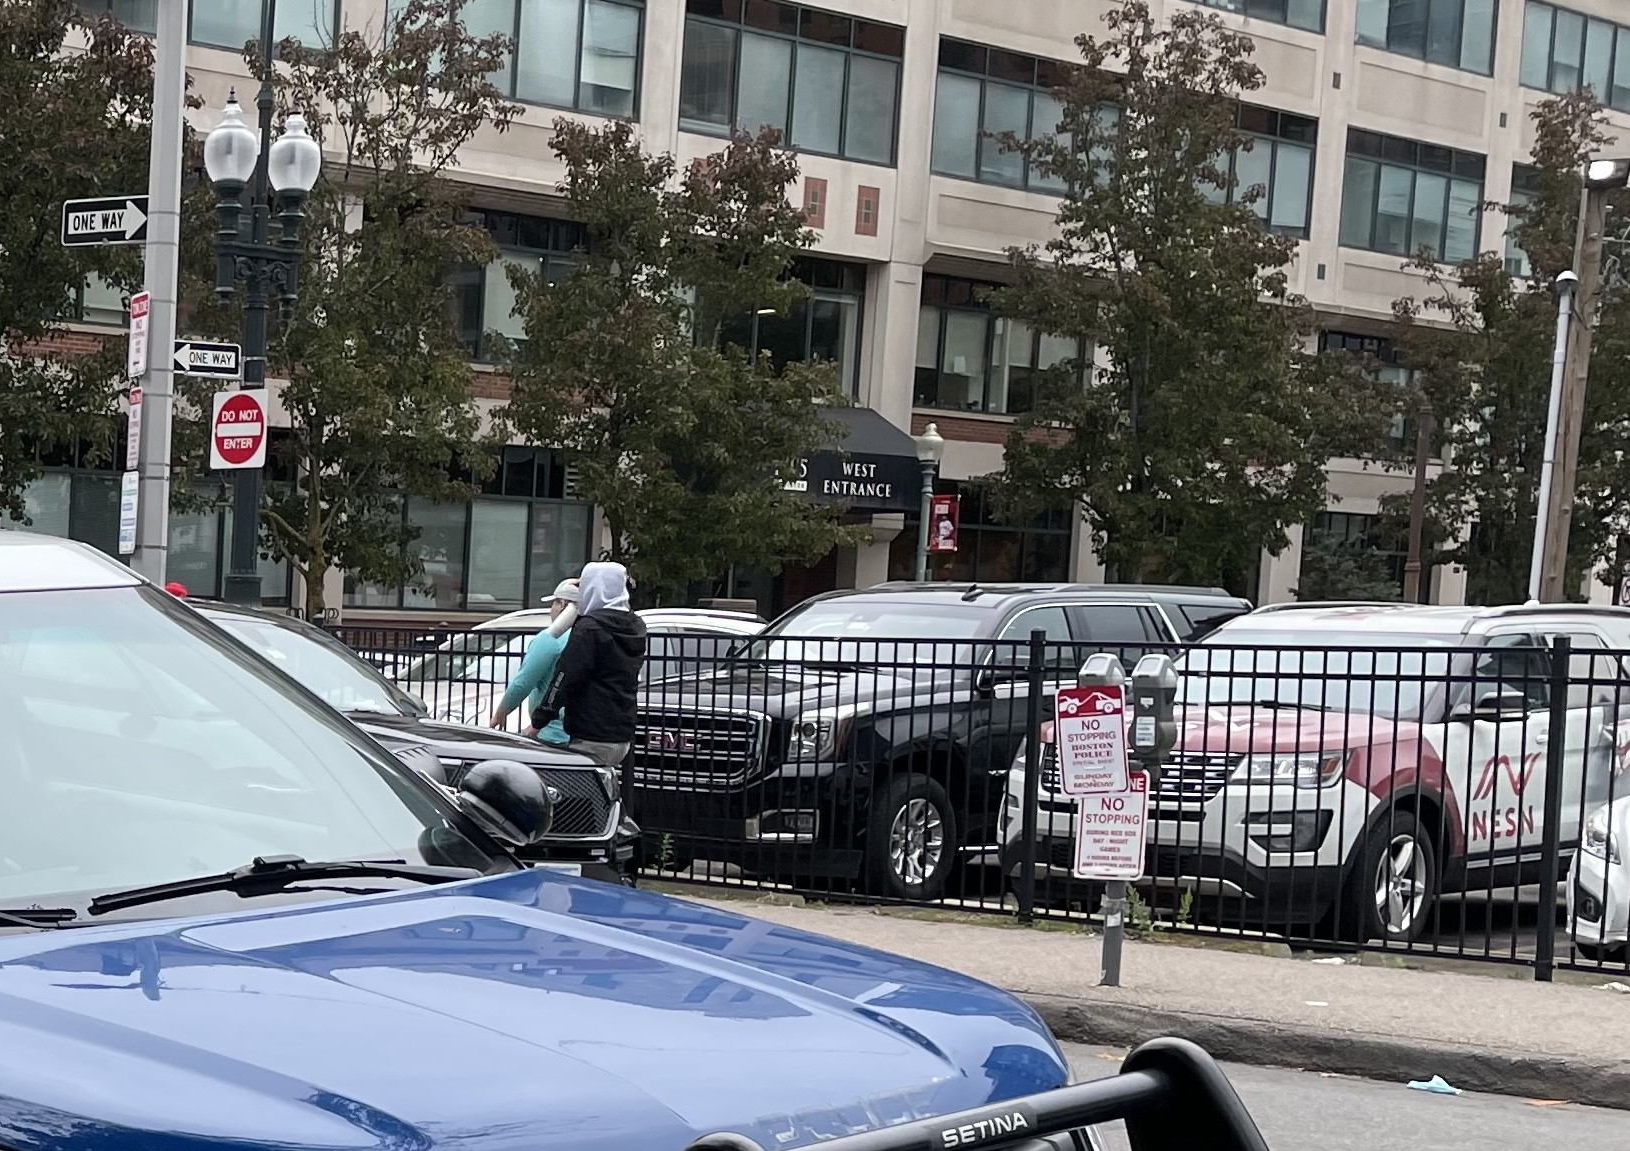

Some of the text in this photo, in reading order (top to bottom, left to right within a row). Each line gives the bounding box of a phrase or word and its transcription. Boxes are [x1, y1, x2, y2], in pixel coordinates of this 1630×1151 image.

[73, 211, 124, 231] ONE WAY
[189, 351, 232, 366] ONE WAY
[222, 409, 259, 422] DO NOT
[223, 438, 253, 449] ENTER
[842, 462, 877, 478] WEST
[823, 479, 892, 498] ENTRANCE
[1081, 719, 1101, 731] NO
[1067, 731, 1117, 743] STOPPING
[1071, 742, 1114, 751] BOSTON
[1074, 750, 1113, 759] POLICE
[1073, 781, 1115, 789] MONDAY
[1101, 798, 1124, 811] NO
[1085, 814, 1140, 825] STOPPING
[1473, 804, 1534, 842] NESN
[941, 1112, 1029, 1149] SETINA
